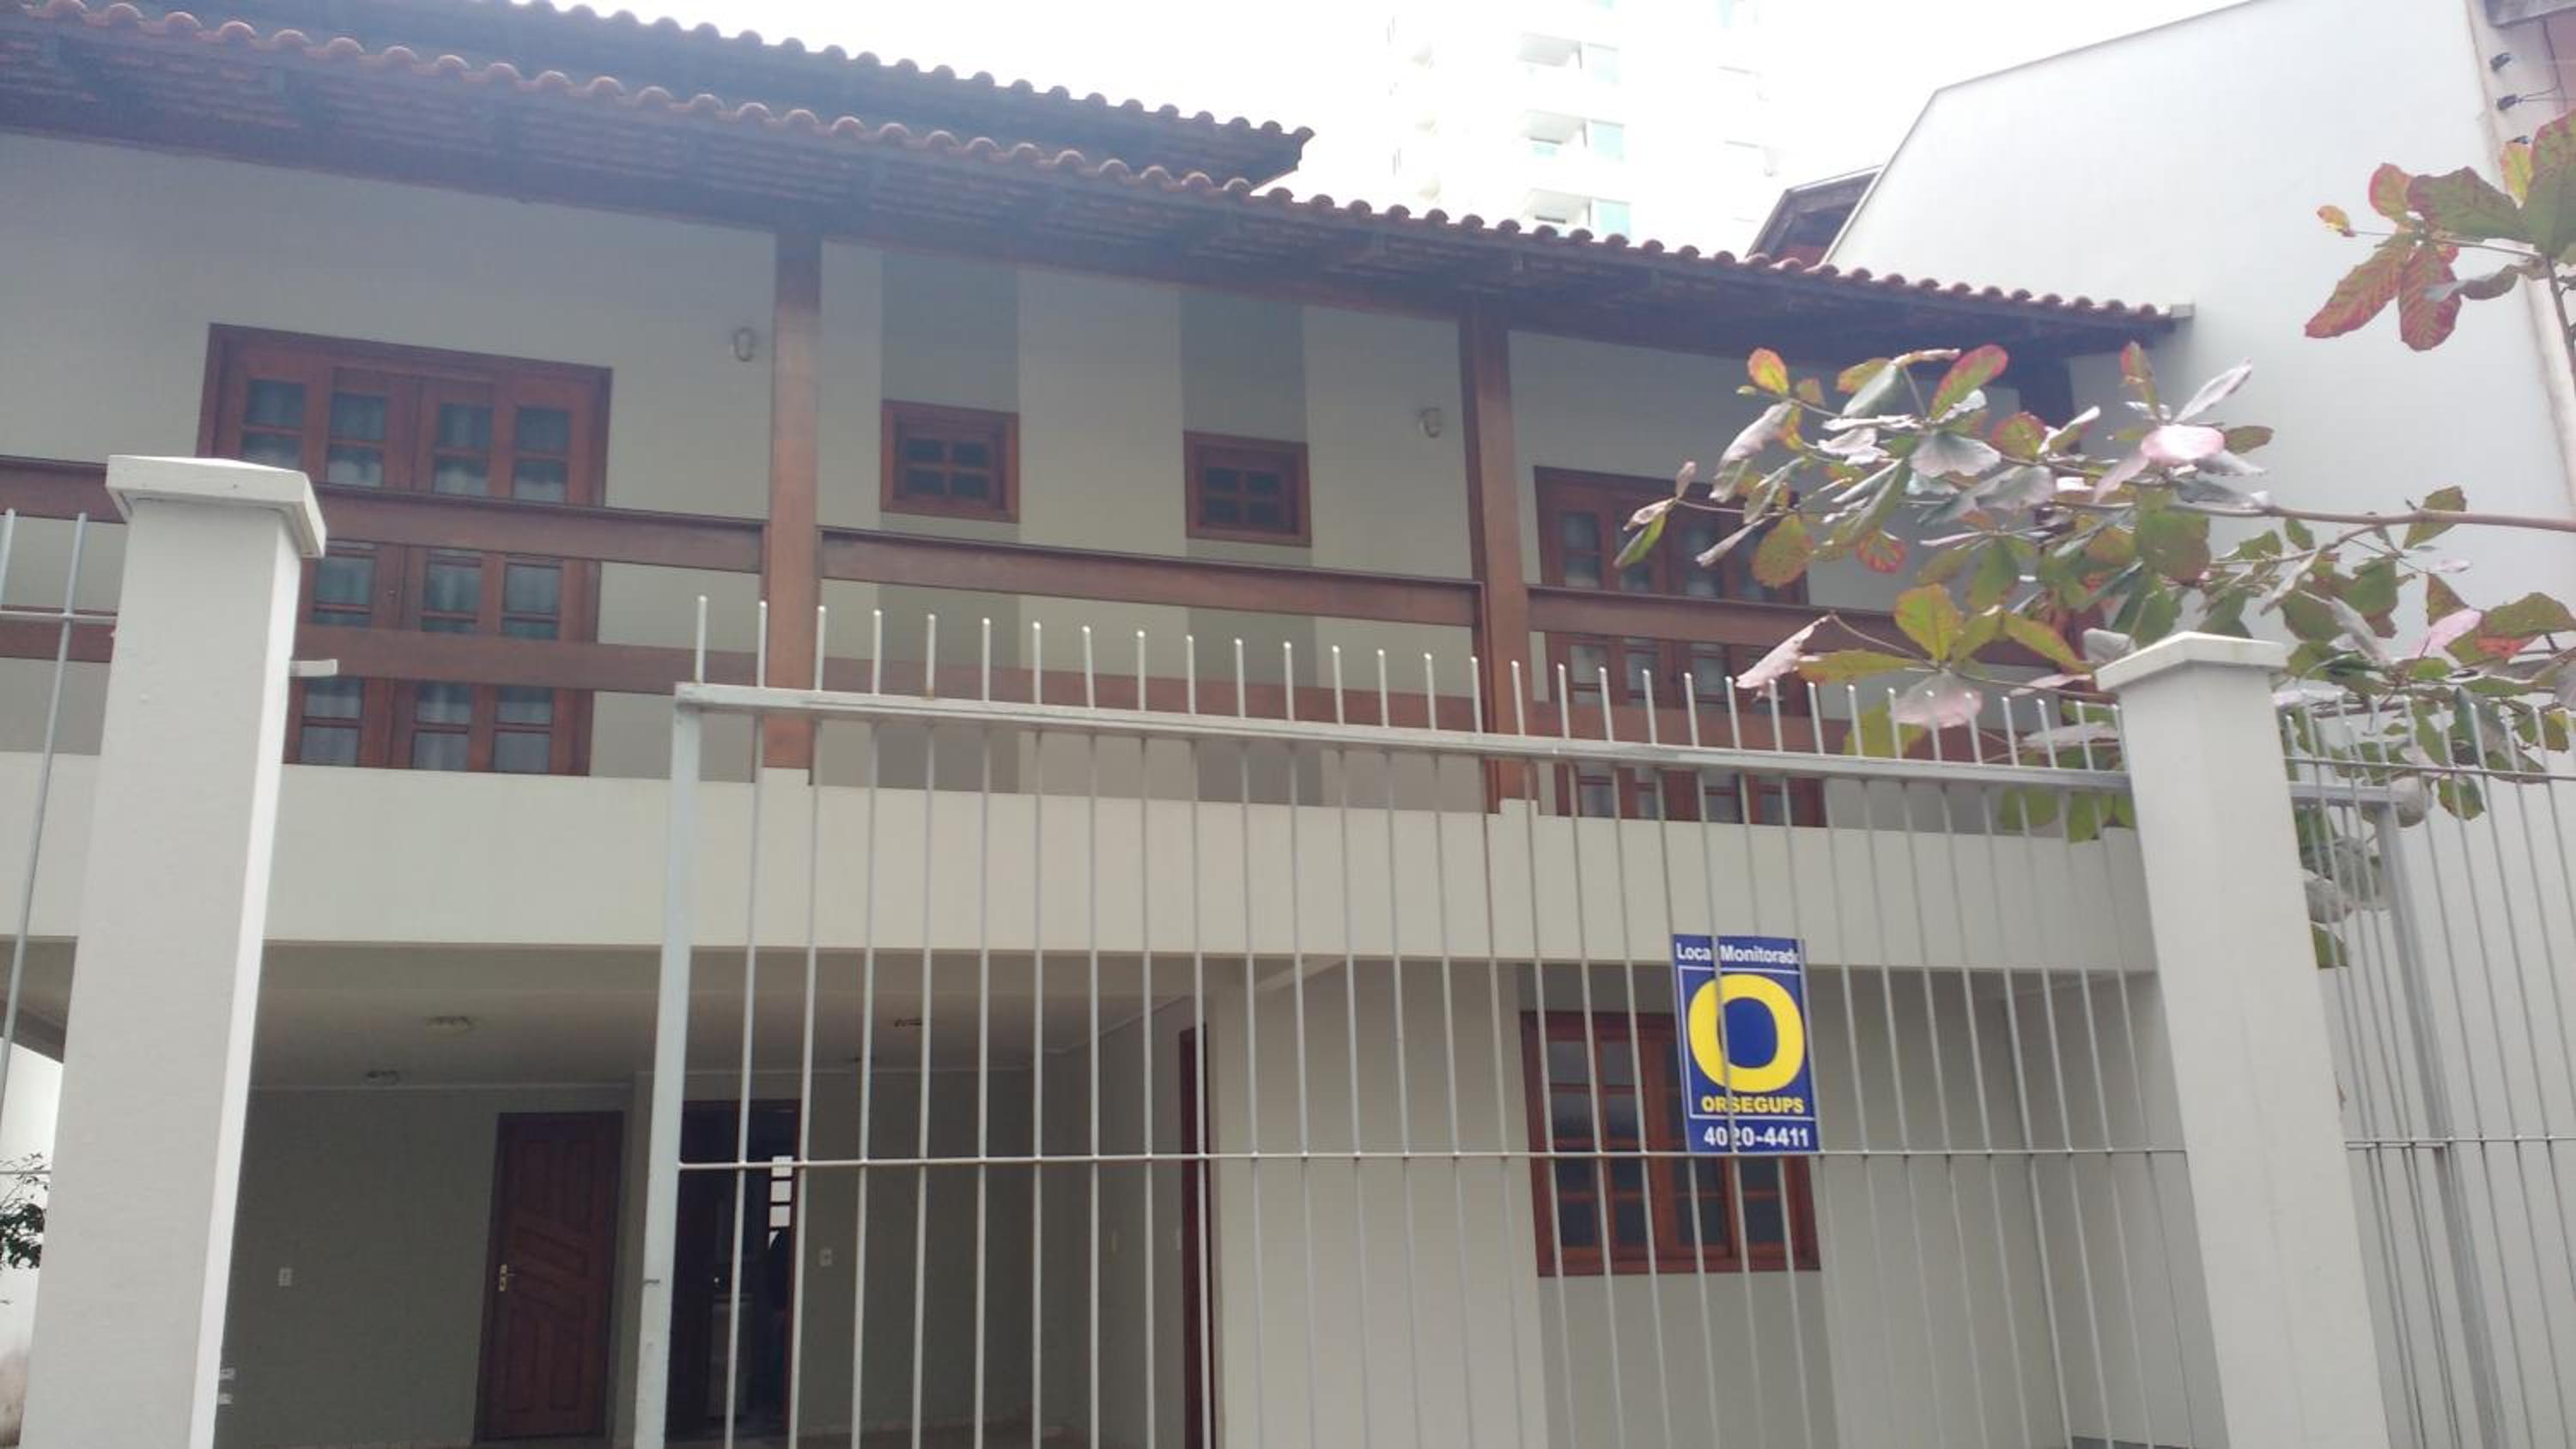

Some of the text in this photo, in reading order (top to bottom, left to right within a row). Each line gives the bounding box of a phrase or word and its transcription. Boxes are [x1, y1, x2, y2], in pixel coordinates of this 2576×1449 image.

[1676, 943, 1713, 961] Loca
[1688, 973, 1804, 1093] O
[1702, 1095, 1805, 1113] ORSEGUPS
[1704, 1125, 1808, 1148] 4020-4411
